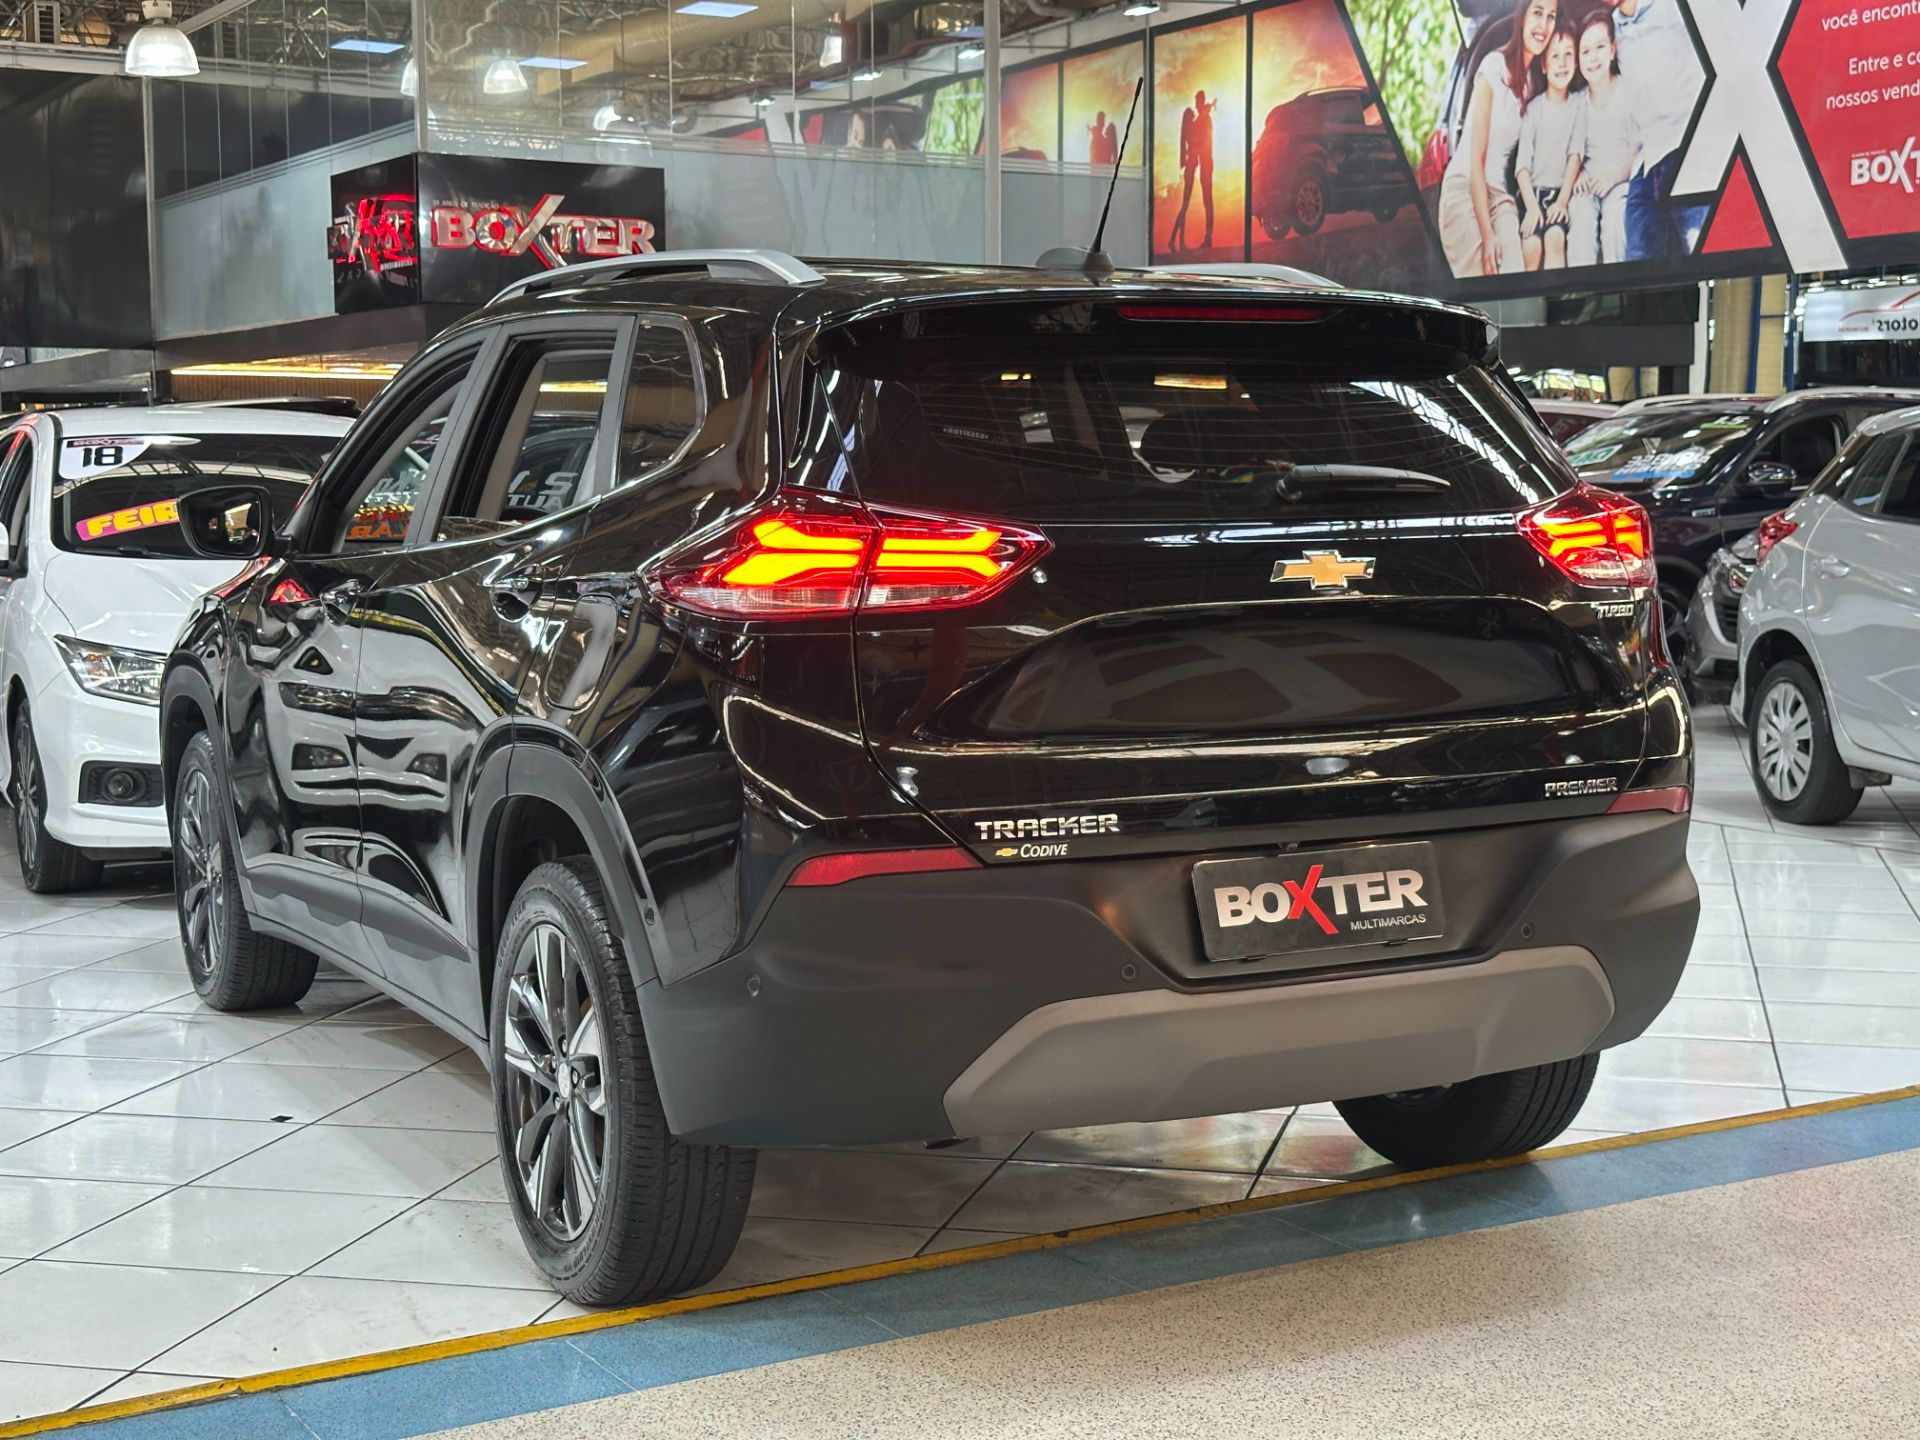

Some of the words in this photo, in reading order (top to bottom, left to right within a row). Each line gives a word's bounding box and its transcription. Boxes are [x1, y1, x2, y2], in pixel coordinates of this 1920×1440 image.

[1821, 8, 1858, 31] você
[1848, 56, 1889, 75] Entre
[1893, 54, 1903, 67] e
[1826, 89, 1879, 110] nossos
[1882, 78, 1920, 101] vend
[430, 193, 657, 270] BOXTER
[82, 446, 124, 468] 18
[1591, 602, 1634, 619] TURBO
[1544, 777, 1618, 797] PREMIER
[974, 813, 1121, 840] TRACKER
[1213, 864, 1429, 935] BOXTER
[1350, 913, 1427, 931] MULTIMARCAS
